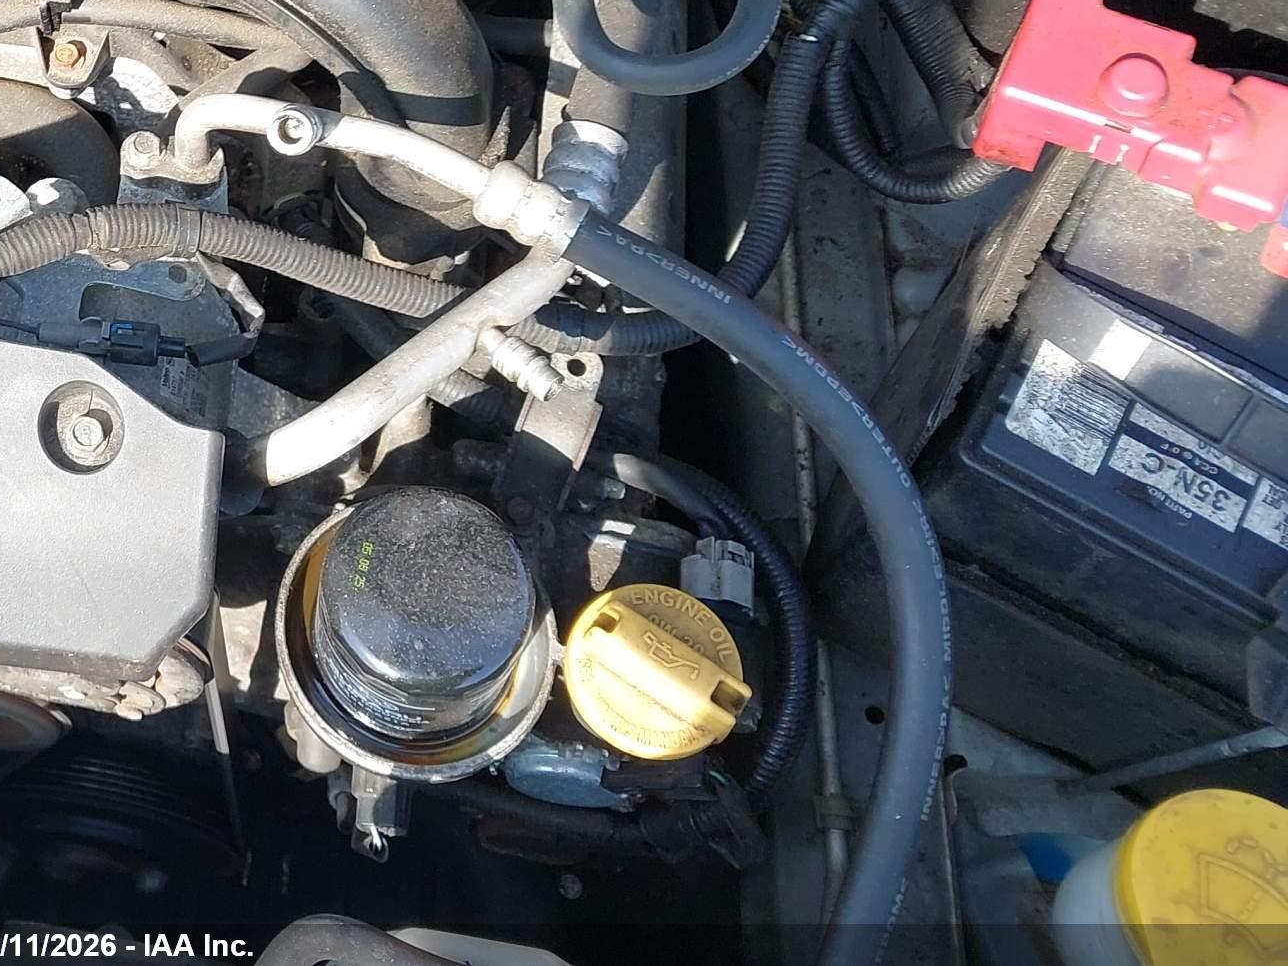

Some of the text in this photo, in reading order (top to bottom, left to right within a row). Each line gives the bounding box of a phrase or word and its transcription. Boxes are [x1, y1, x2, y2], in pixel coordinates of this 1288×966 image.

[1139, 451, 1232, 514] 35N-C
[632, 589, 734, 665] ENGINE OIL
